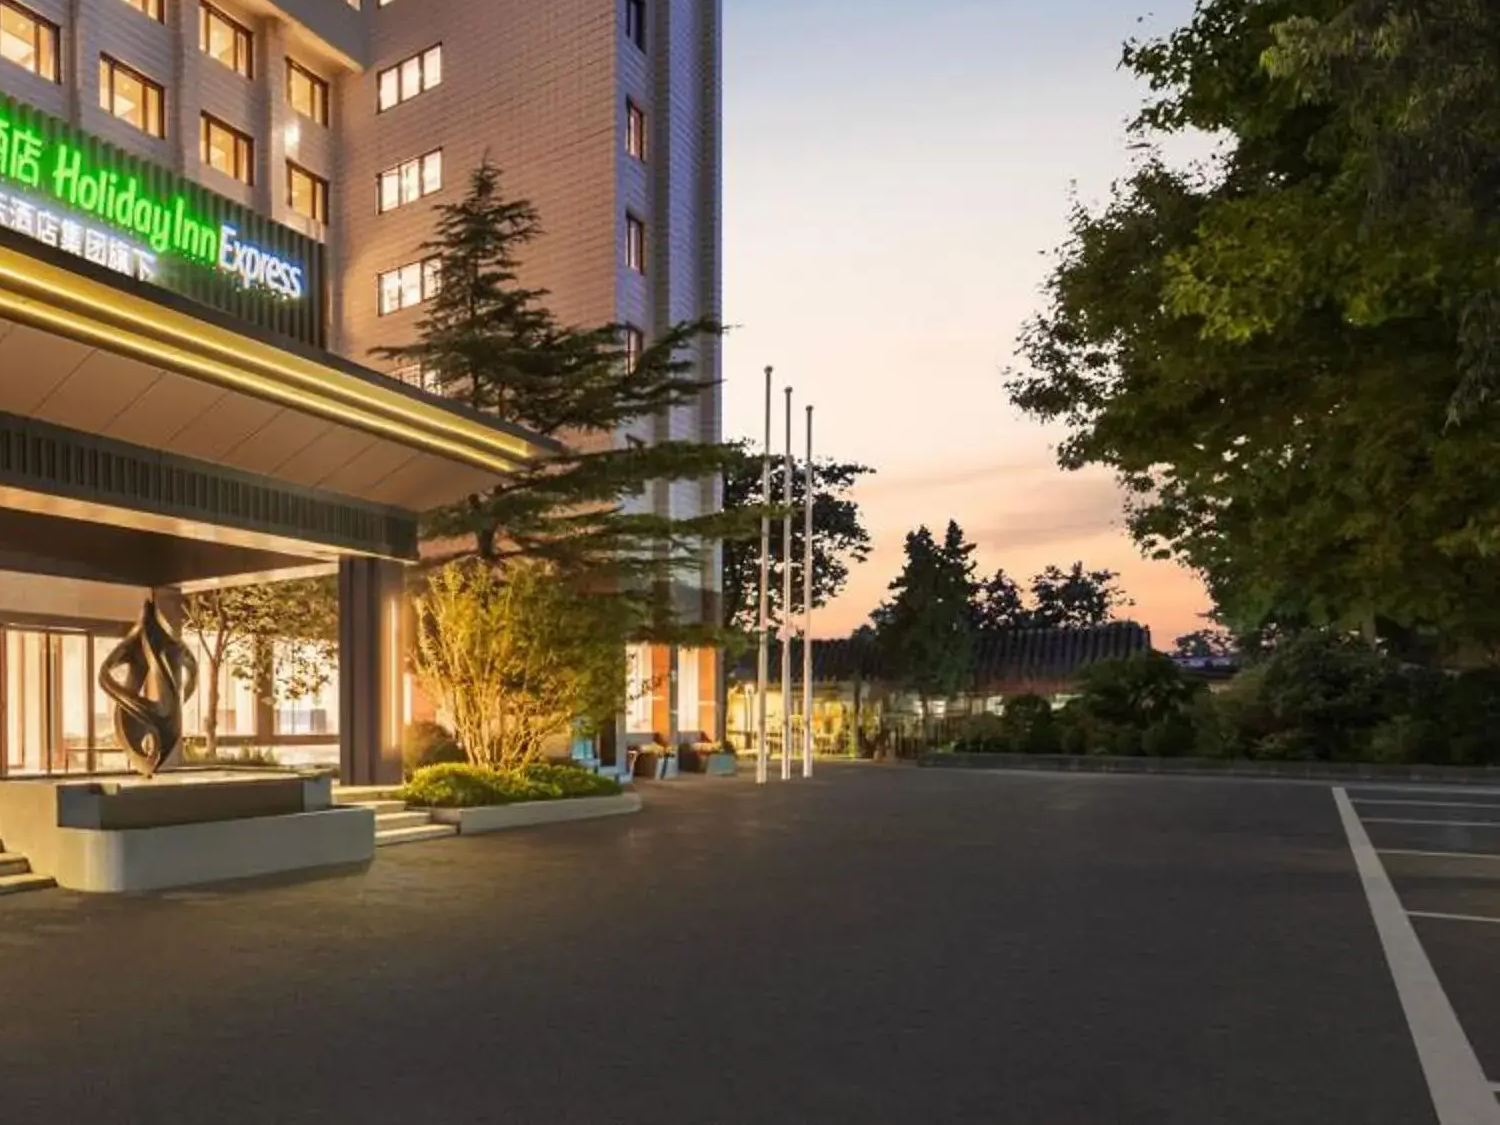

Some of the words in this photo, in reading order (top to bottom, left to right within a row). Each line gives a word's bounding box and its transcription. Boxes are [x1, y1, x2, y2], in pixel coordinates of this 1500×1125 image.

[52, 144, 171, 253] Holiday
[173, 196, 218, 262] Inn
[218, 224, 302, 300] Express
